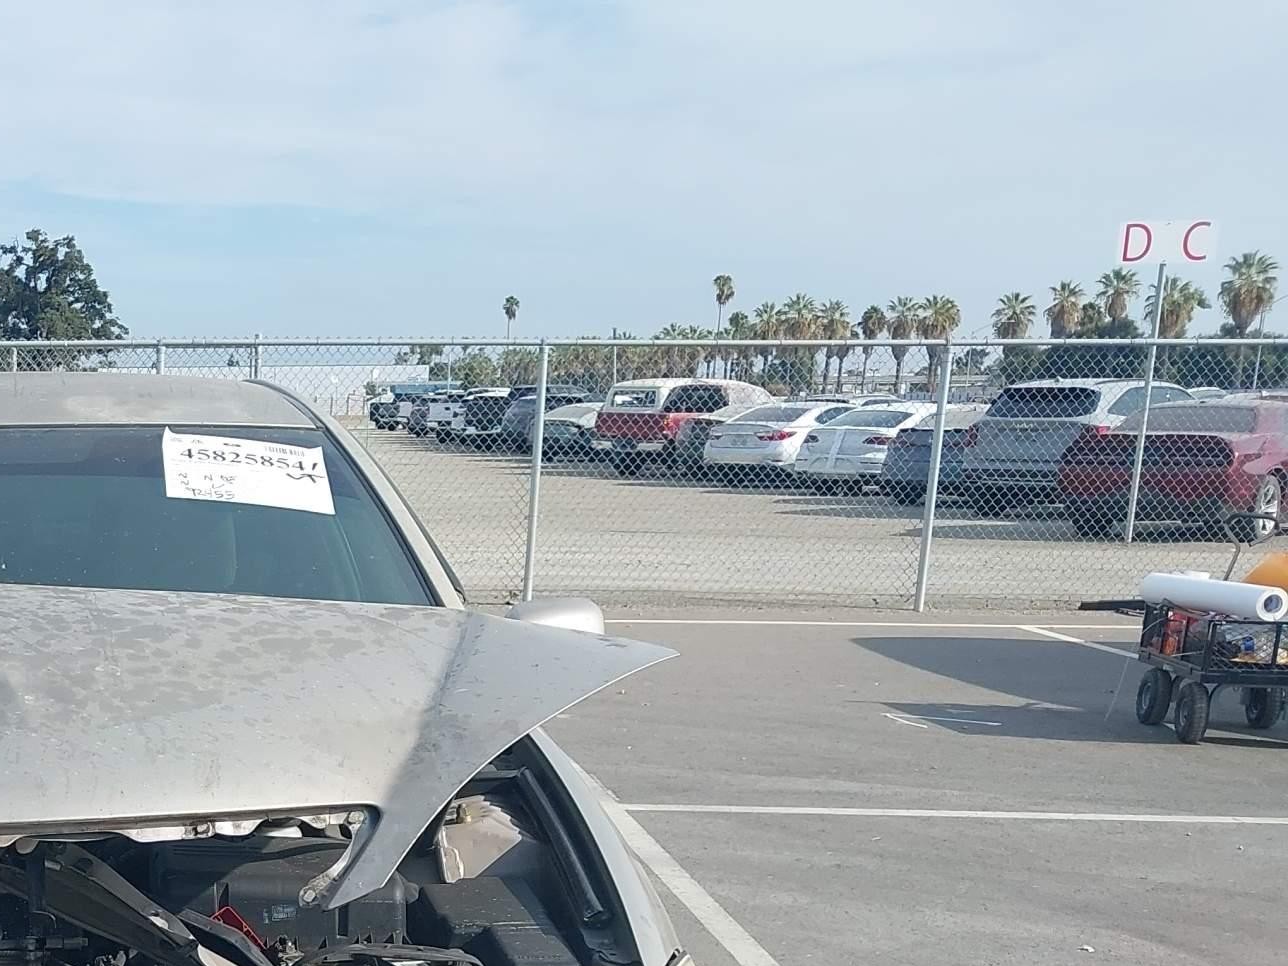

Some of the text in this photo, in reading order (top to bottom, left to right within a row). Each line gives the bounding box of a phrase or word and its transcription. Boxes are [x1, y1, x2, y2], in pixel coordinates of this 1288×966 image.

[1122, 221, 1211, 261] D C
[180, 447, 305, 471] 45825854
